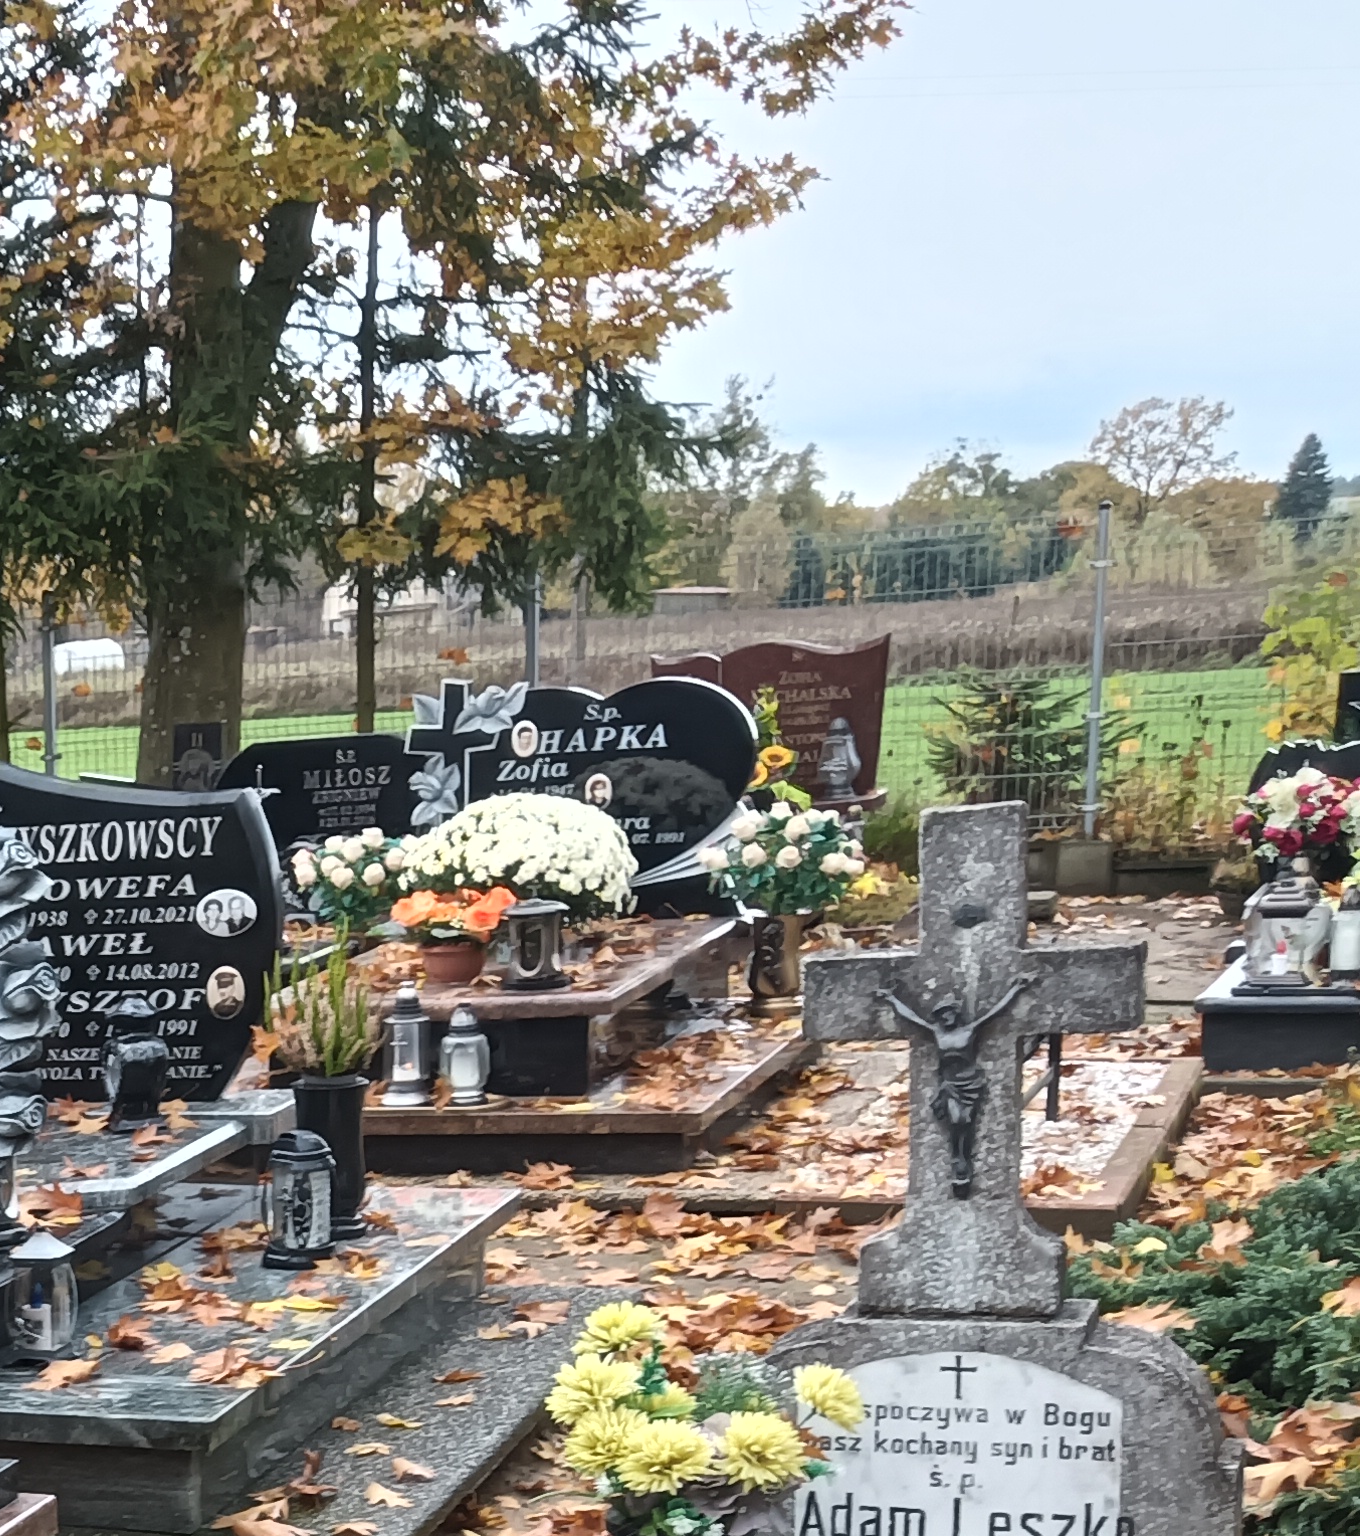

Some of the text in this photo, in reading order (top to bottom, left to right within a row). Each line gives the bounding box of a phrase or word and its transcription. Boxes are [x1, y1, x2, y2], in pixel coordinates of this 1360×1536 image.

[536, 724, 669, 755] HAPKA
[303, 766, 392, 789] MIŁOSZ
[496, 757, 570, 783] Zofia
[18, 816, 222, 865] YSZKOWSCY
[43, 873, 197, 902] OWEFA
[40, 932, 154, 957] AWEŁ
[1006, 1407, 1027, 1426] w
[1043, 1402, 1112, 1435] Bogu
[819, 1434, 862, 1453] asz
[873, 1430, 978, 1464] kochany
[990, 1440, 1033, 1466] syn
[1058, 1439, 1116, 1463] brat
